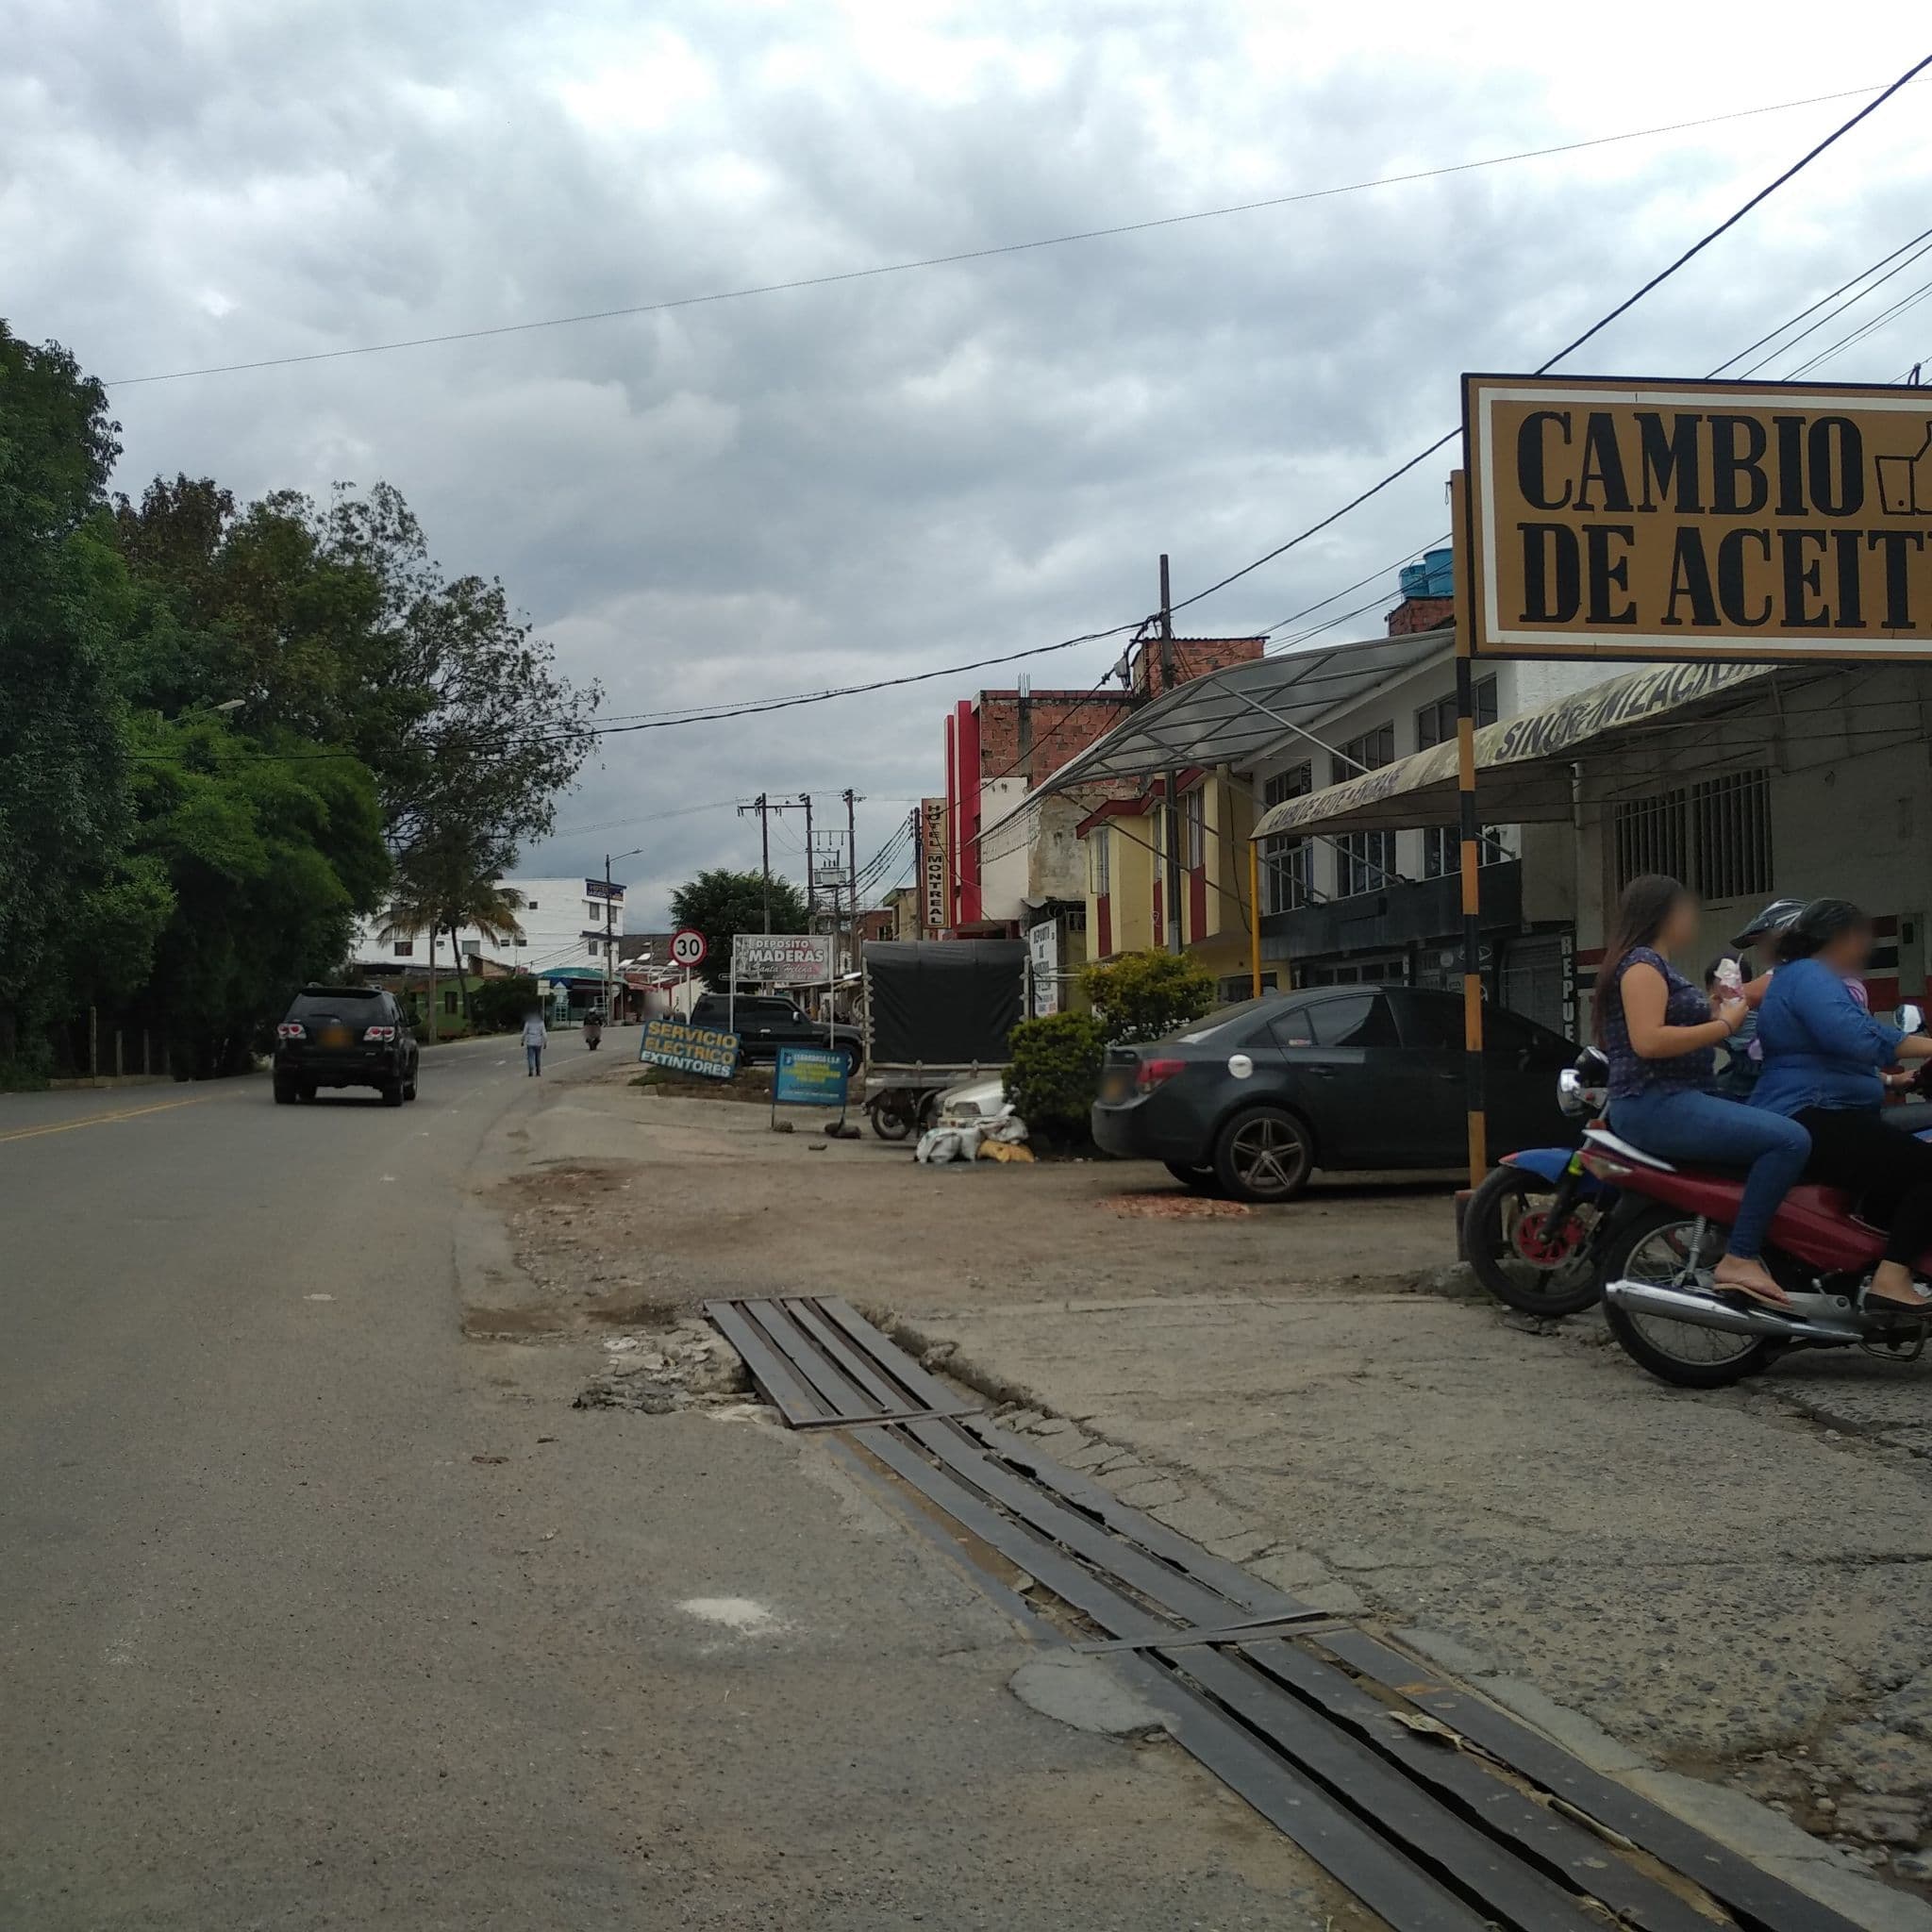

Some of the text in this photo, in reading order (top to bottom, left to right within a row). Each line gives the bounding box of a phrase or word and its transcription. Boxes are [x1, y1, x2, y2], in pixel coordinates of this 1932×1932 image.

[1517, 410, 1864, 516] CAMBIO
[1517, 522, 1932, 629] DE ACEIT
[927, 805, 942, 924] HOTEL MONTREAL
[676, 939, 700, 957] 30
[748, 949, 824, 963] MADERAS
[756, 940, 809, 948] DEPOSITO
[753, 962, 779, 973] Santa
[647, 1020, 739, 1049] SERVICIO
[641, 1050, 731, 1077] EXTINTORES
[644, 1036, 736, 1065] ELECTRICO
